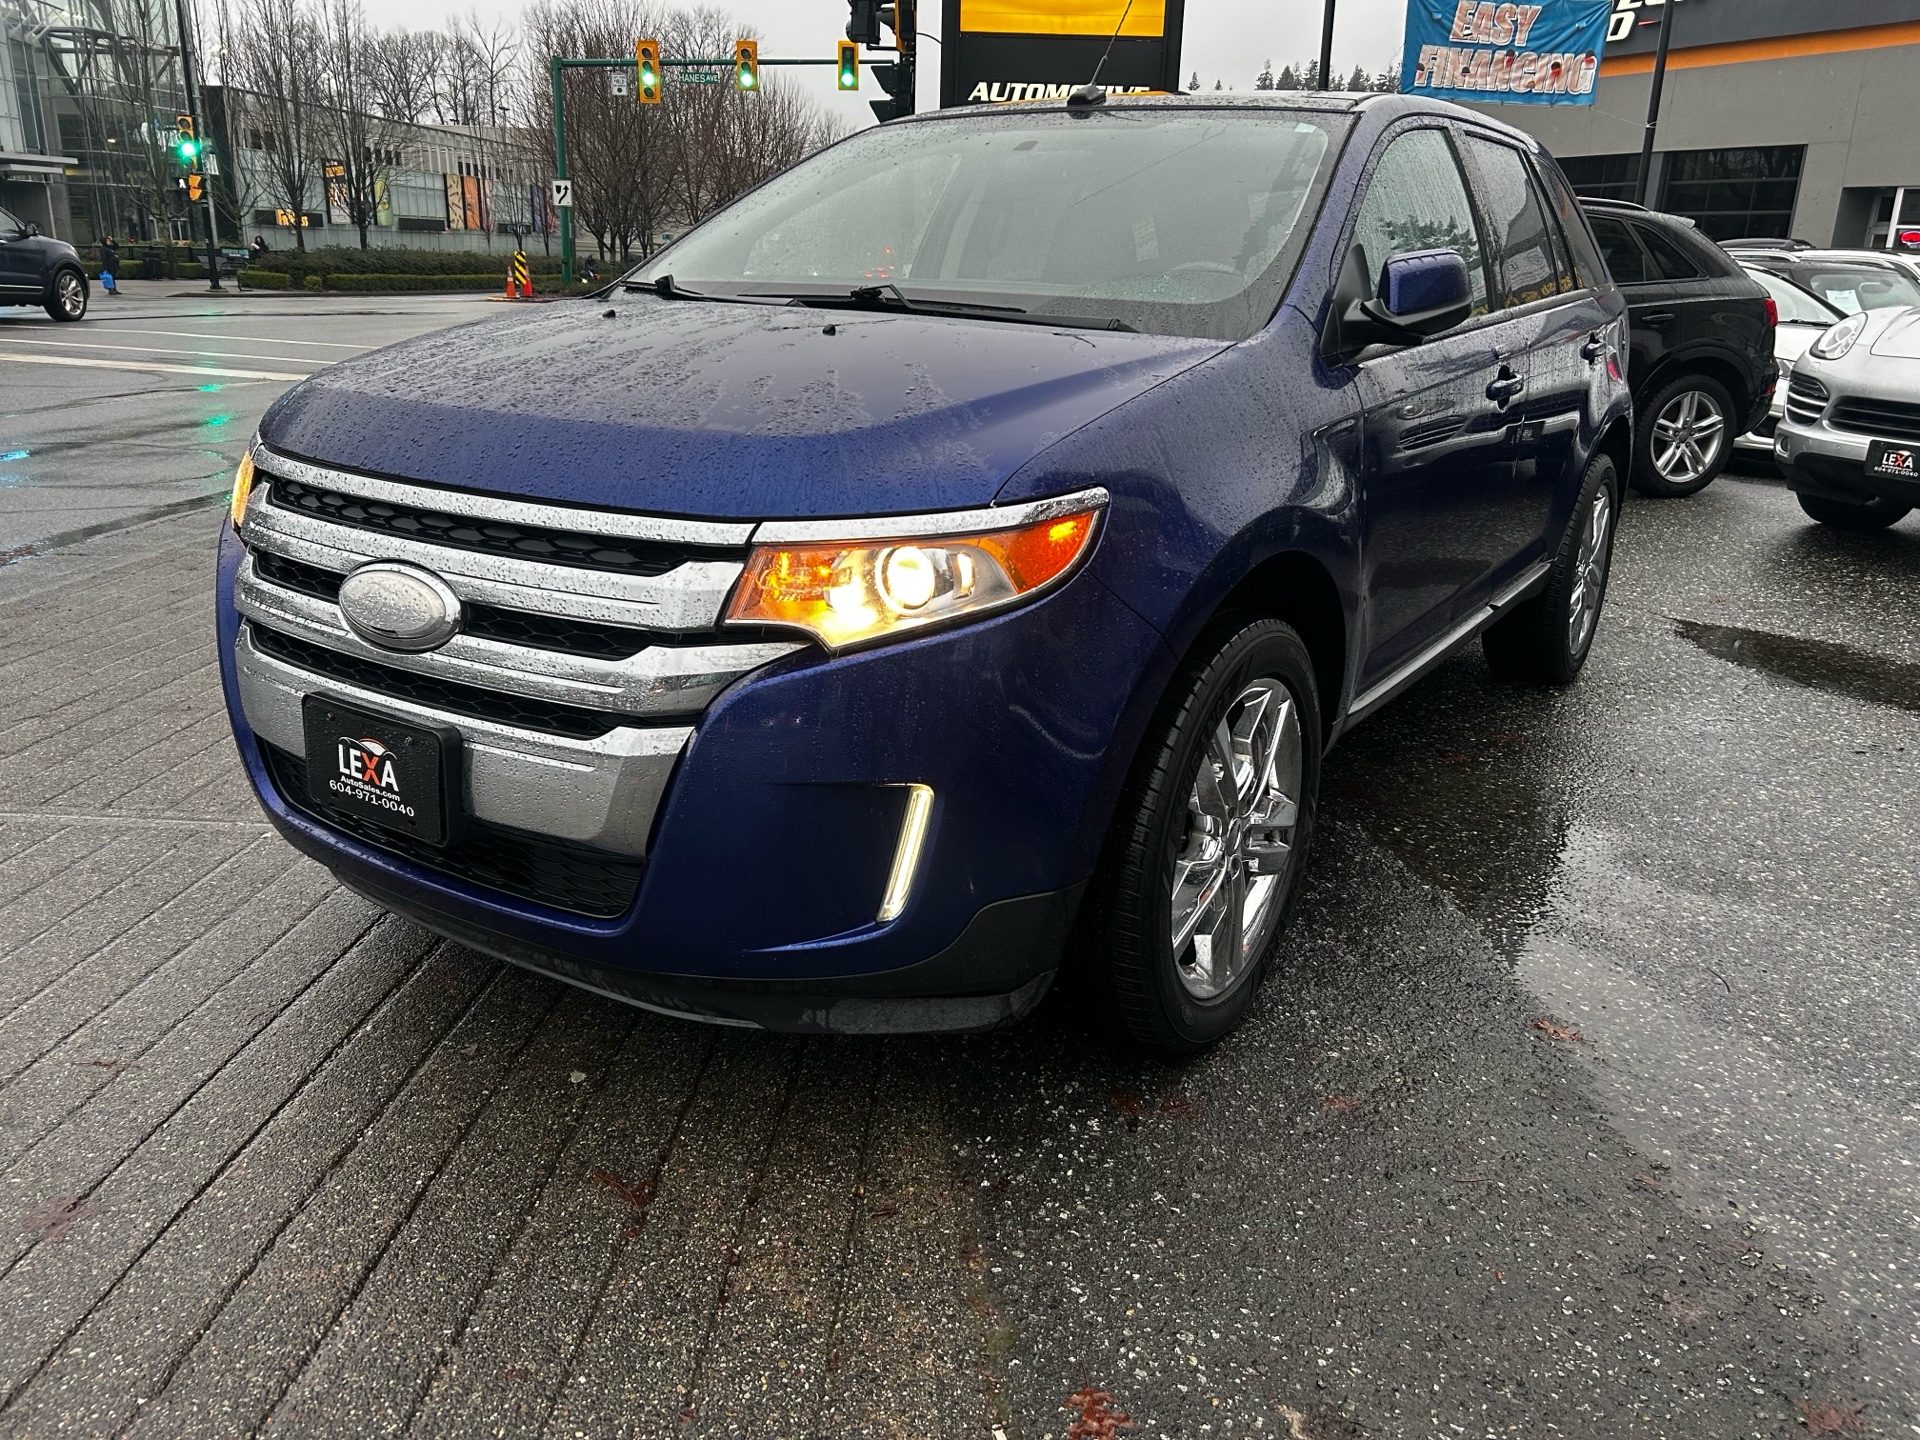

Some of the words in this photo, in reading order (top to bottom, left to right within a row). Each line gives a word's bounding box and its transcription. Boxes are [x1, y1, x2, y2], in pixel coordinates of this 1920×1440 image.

[1449, 0, 1543, 47] EASY
[679, 73, 706, 83] HANES
[706, 73, 719, 82] AVE
[1414, 44, 1598, 95] FINANCING
[968, 81, 1150, 101] AUTOMI
[1882, 452, 1913, 469] LEXA
[338, 743, 399, 792] LEXA
[329, 779, 415, 817] 604-971-0040
[341, 775, 401, 801] AutoSales.com
